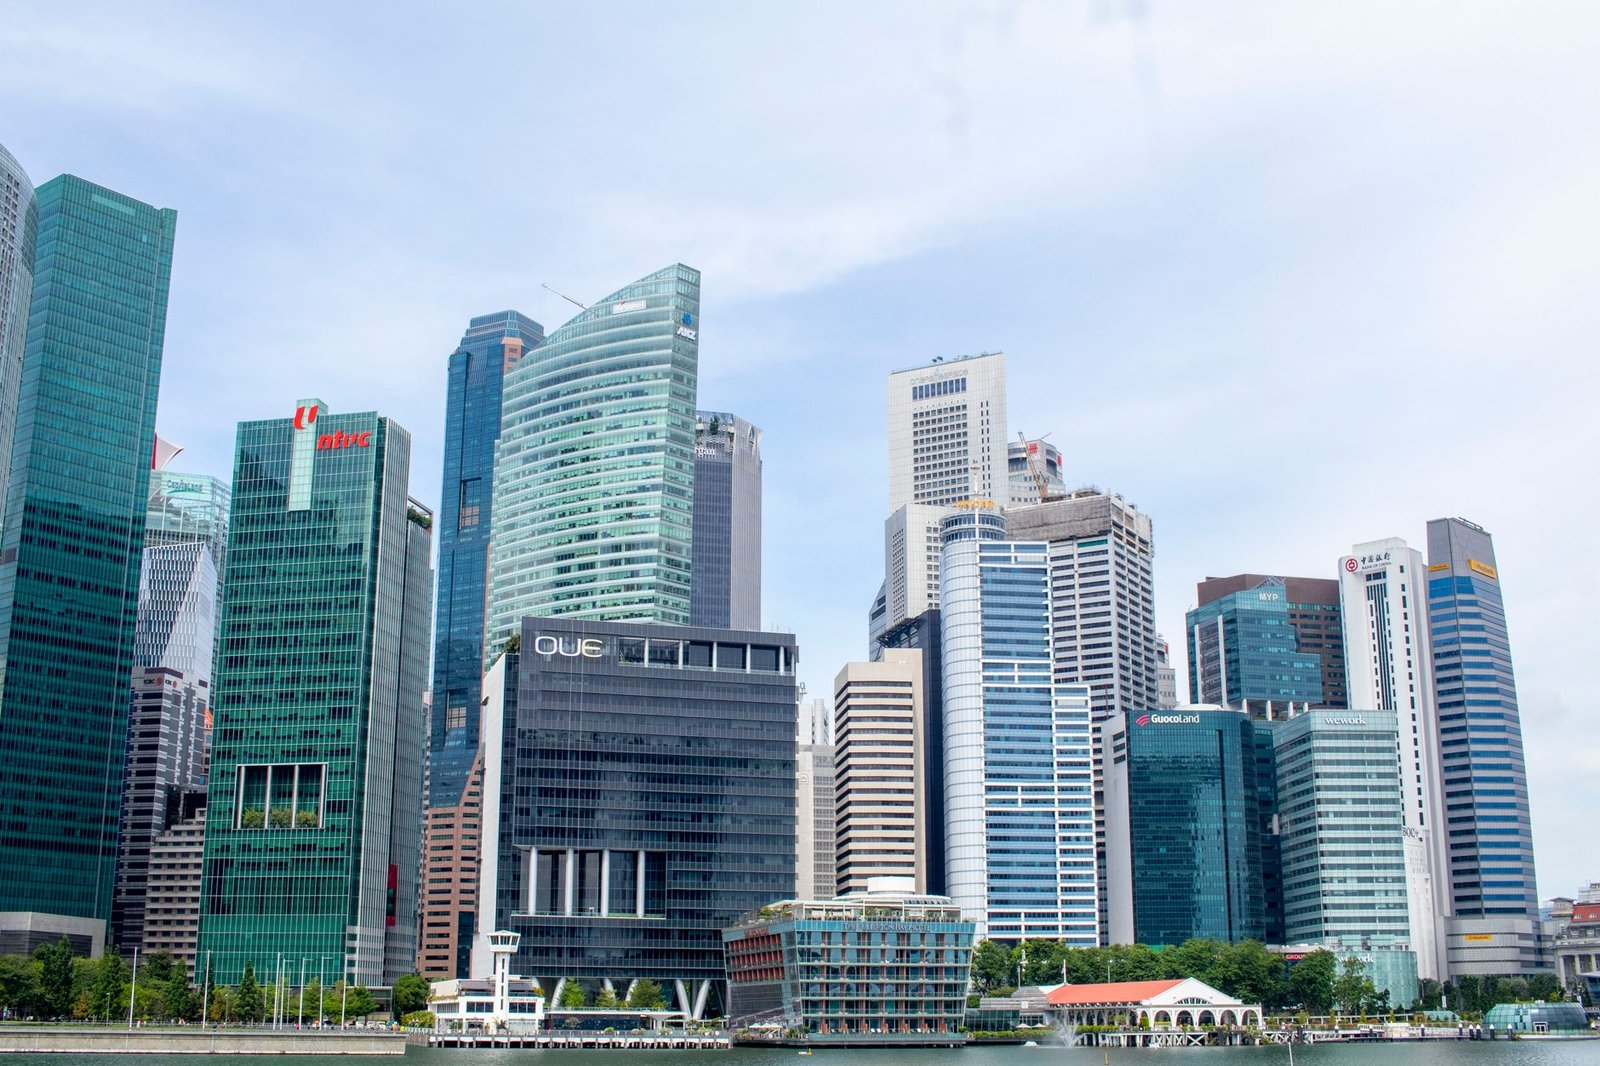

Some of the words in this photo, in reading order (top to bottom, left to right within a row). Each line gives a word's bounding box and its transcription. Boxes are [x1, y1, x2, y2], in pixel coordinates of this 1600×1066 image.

[677, 327, 695, 340] ANZ
[317, 429, 371, 450] ntuc
[694, 445, 716, 457] rgan
[1259, 592, 1278, 602] MYP
[535, 635, 604, 658] OUE
[1151, 713, 1200, 724] GuocoLand
[1324, 712, 1367, 726] wework
